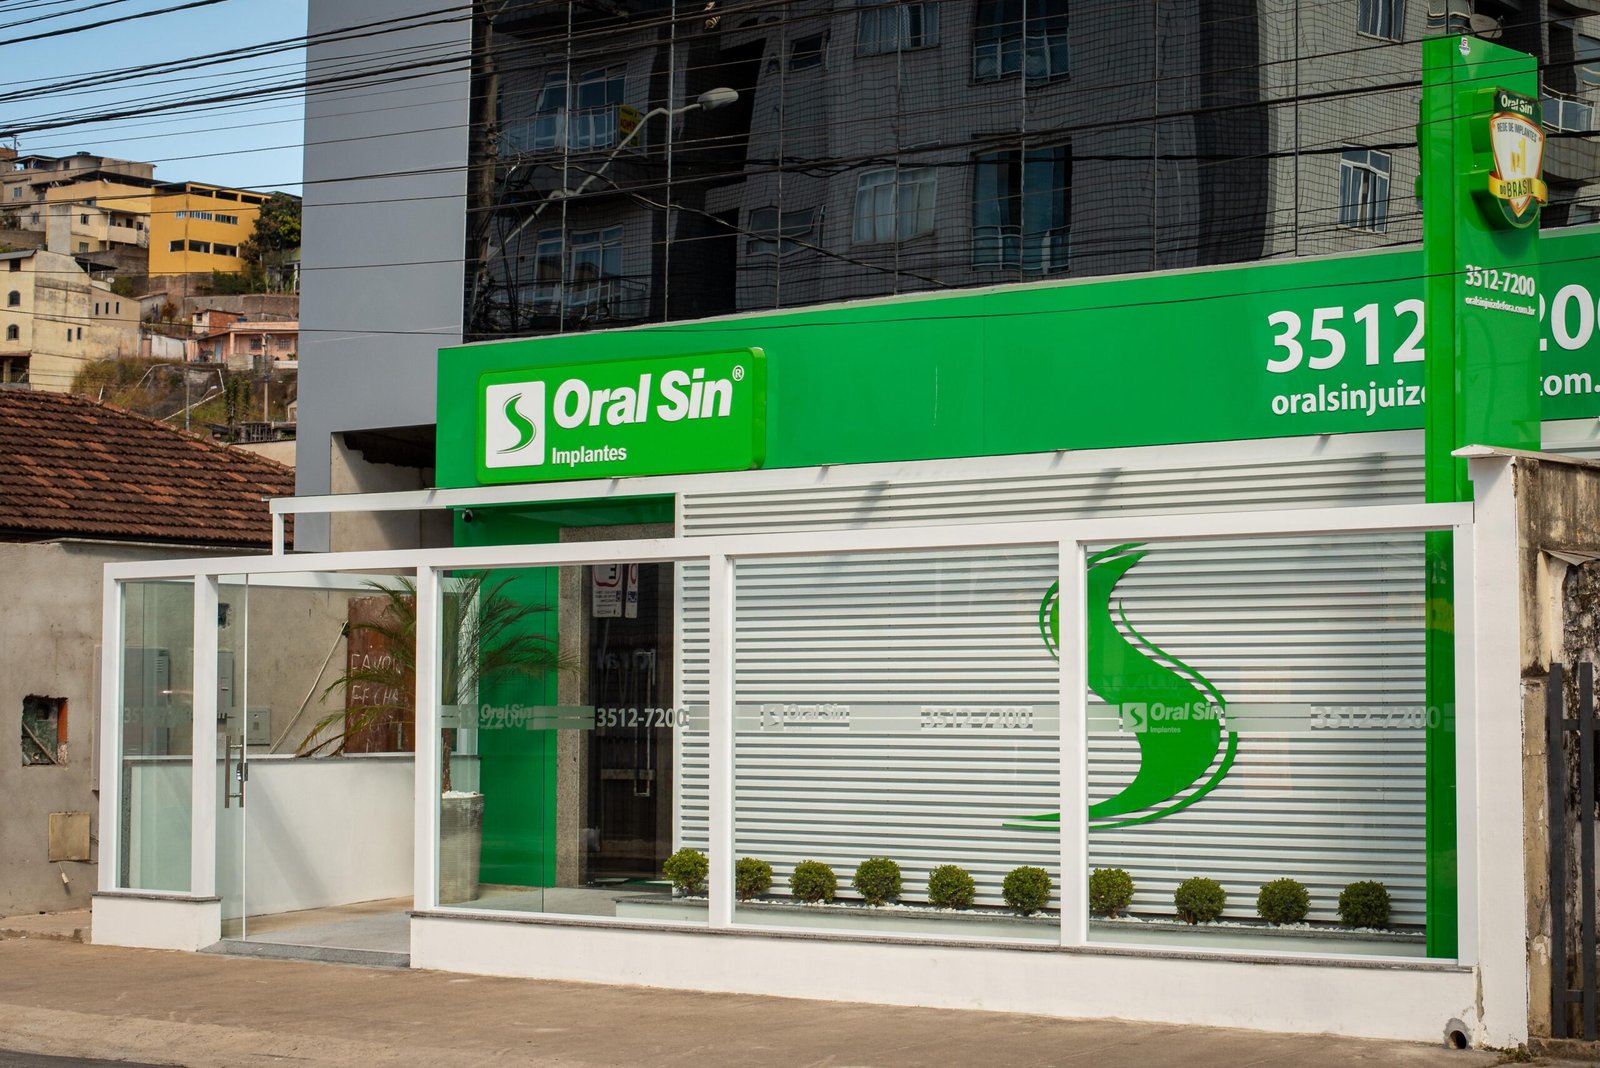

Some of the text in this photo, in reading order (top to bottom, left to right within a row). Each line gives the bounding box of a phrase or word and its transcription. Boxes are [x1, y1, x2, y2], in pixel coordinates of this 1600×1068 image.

[1501, 94, 1533, 115] Oral Sin
[1497, 122, 1537, 144] REDE DE IMPLANTES
[1500, 177, 1535, 198] DO BRASIL
[1465, 264, 1536, 297] 3512-7200
[553, 373, 652, 429] Oral
[551, 444, 627, 468] Implantes
[596, 707, 688, 728] 3512-7200
[787, 703, 847, 720] Oral Sin
[922, 707, 1033, 729] 3512-7200
[1150, 702, 1224, 721] Oral Sin
[1314, 706, 1440, 729] 3512-7200
[1150, 726, 1181, 734] Implantes
